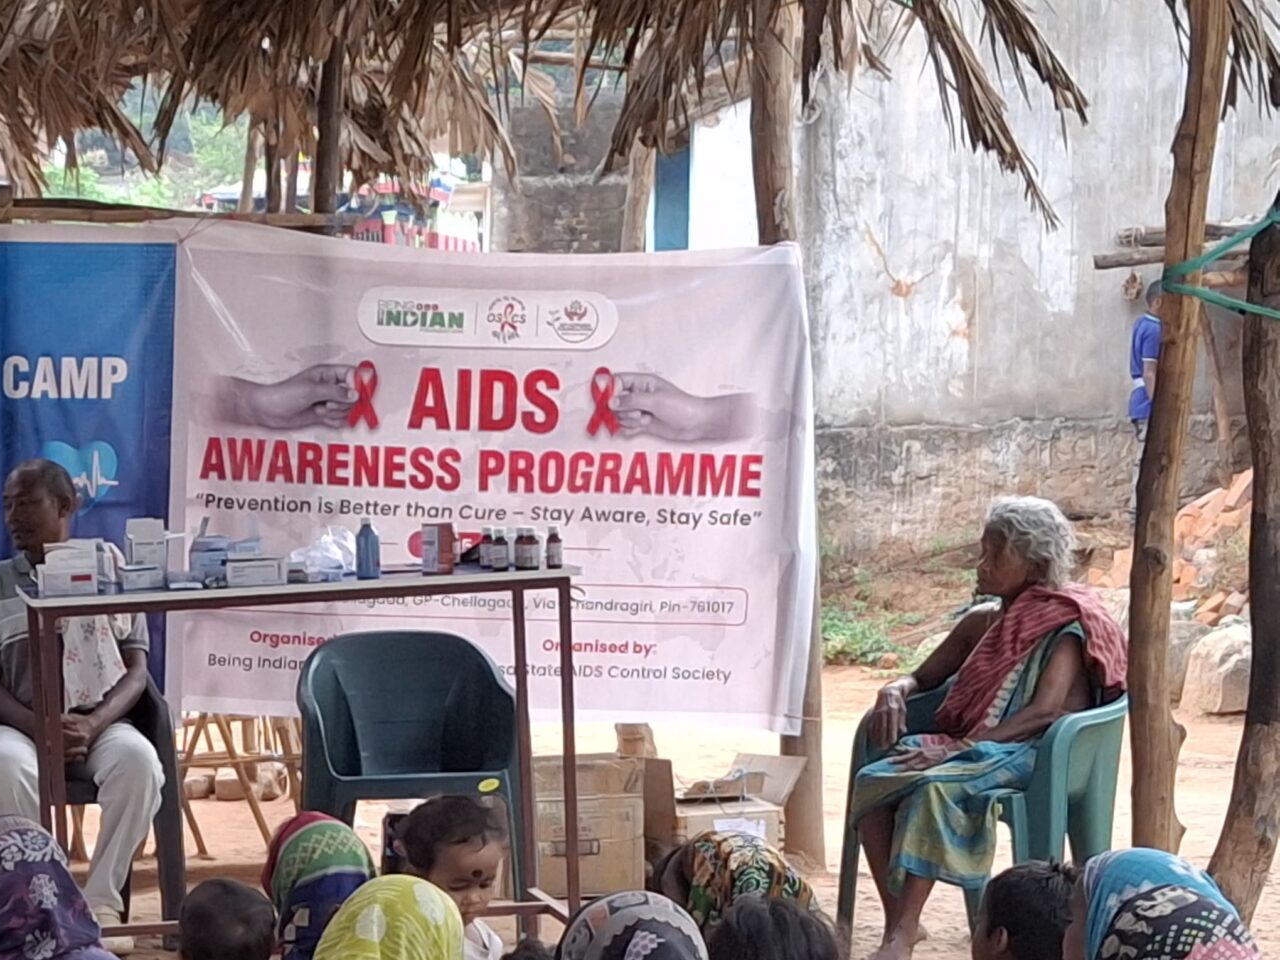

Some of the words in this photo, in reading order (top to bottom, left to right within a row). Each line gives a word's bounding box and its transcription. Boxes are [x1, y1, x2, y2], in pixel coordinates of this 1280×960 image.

[377, 310, 464, 329] INDIAN
[2, 355, 128, 399] CAMP
[408, 368, 559, 435] AIDS
[200, 437, 461, 492] AWARENESS
[479, 450, 764, 498] PROGRAMME
[196, 493, 311, 514] “Prevention
[318, 496, 333, 514] is
[339, 499, 400, 517] Better
[406, 501, 453, 519] than
[459, 505, 507, 521] Cure
[531, 506, 574, 526] Stay
[580, 507, 650, 526] Aware,
[656, 509, 702, 530] Stay
[708, 510, 762, 526] Safe”
[659, 600, 734, 614] Pin-761017
[249, 630, 337, 648] Organise
[542, 639, 629, 655] Oranised
[633, 641, 657, 657] by:
[208, 653, 253, 671] Being
[608, 665, 668, 680] Control
[672, 666, 732, 684] Society
